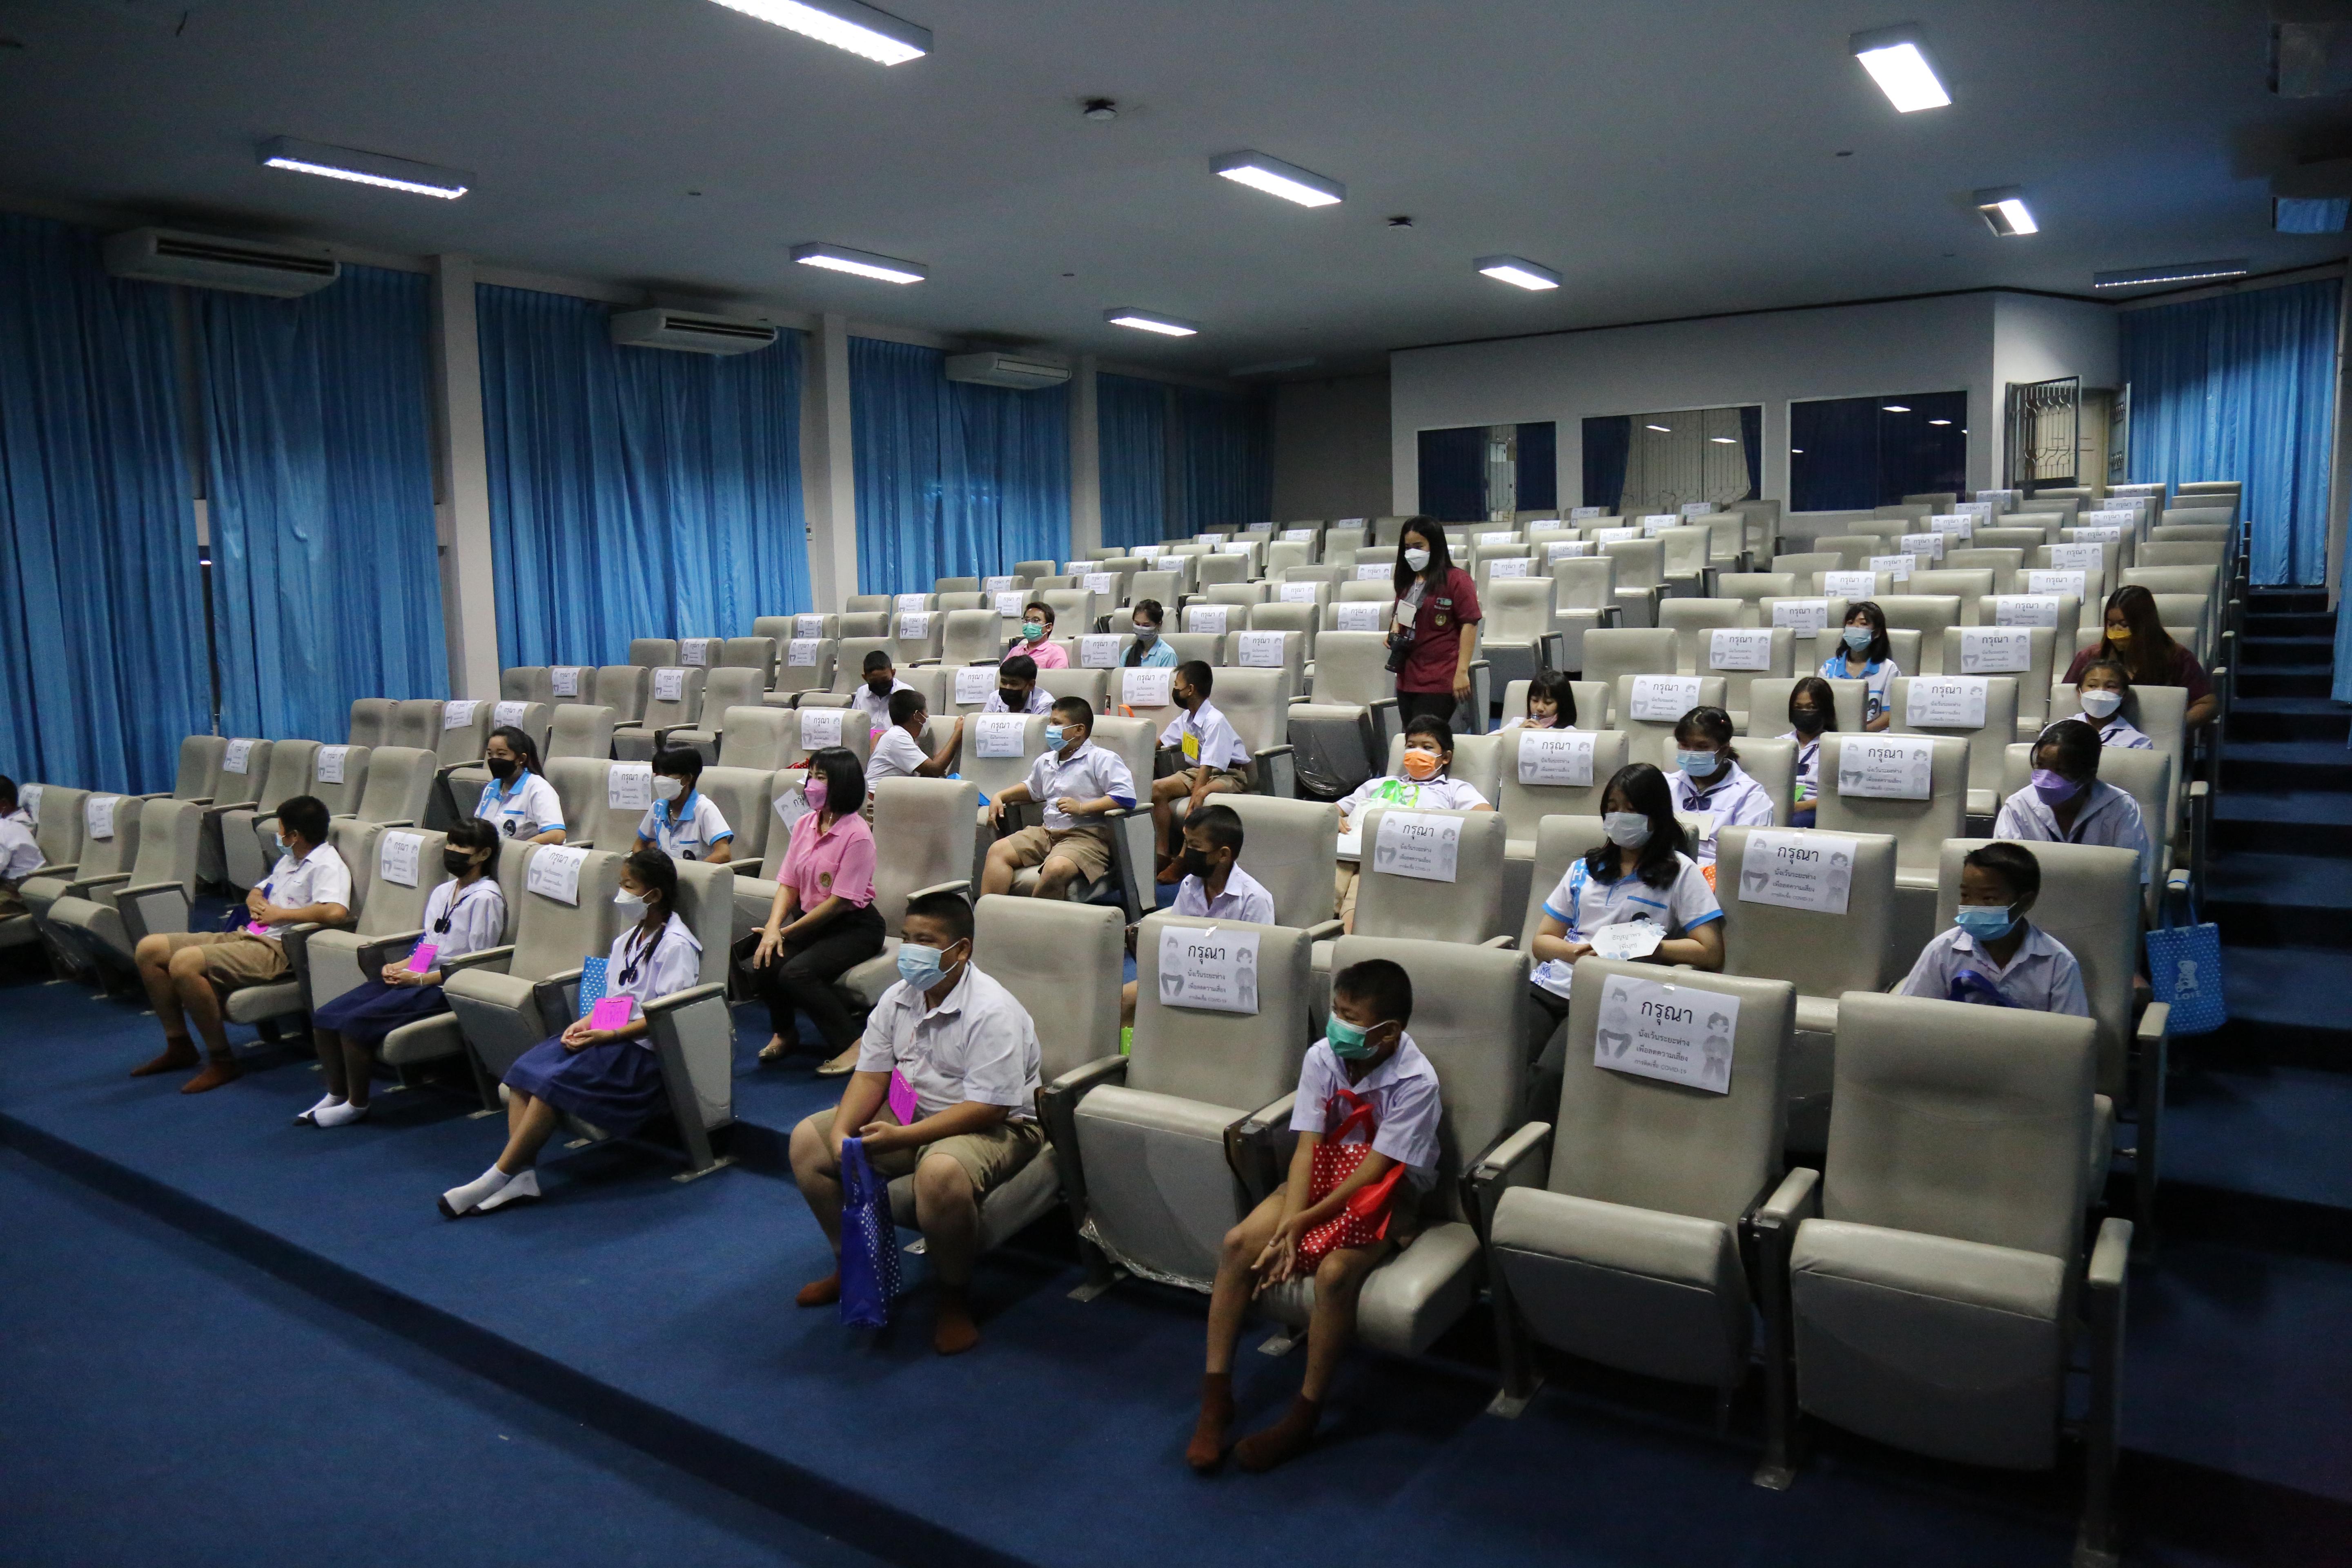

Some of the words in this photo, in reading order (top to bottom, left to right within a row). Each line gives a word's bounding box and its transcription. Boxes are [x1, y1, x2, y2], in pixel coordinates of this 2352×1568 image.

[2067, 549, 2087, 557] กรุณา
[1840, 577, 1860, 585] กรุณา
[2046, 576, 2067, 585] กรุณา
[1351, 608, 1367, 616] กรุณา
[1789, 608, 1810, 617] กรุณา
[2015, 602, 2039, 612] กรุณา
[1252, 637, 1270, 646] กรุณา
[1729, 636, 1752, 645] กรุณา
[1982, 635, 2009, 646] กรุณา
[967, 673, 983, 682] กรุณา
[1137, 674, 1155, 684] กรุณา
[1653, 684, 1678, 694] กรุณา
[1932, 686, 1962, 697] กรุณา
[814, 717, 830, 726] กรุณา
[991, 722, 1009, 732] กรุณา
[1542, 742, 1570, 754] กรุณา
[1869, 748, 1903, 762] กรุณา
[621, 773, 638, 783] กรุณา
[1403, 824, 1434, 840] กรุณา
[549, 853, 569, 864] กรุณา
[1777, 846, 1819, 865] กรุณา
[1775, 869, 1816, 880] นั่งเว้นระยะห่าง
[1773, 881, 1815, 892] เพื่อลดความเสี่ยง
[1188, 945, 1225, 965] กรุณา
[1188, 969, 1225, 981] นั่งเว้นระยะห่าง
[1642, 1001, 1693, 1025] กรุณา
[1639, 1029, 1690, 1047] นั่งเว้นระยะห่าง
[1637, 1046, 1688, 1062] เพื่อลดความเสี่ยง
[1661, 1064, 1687, 1075] COVID-19
